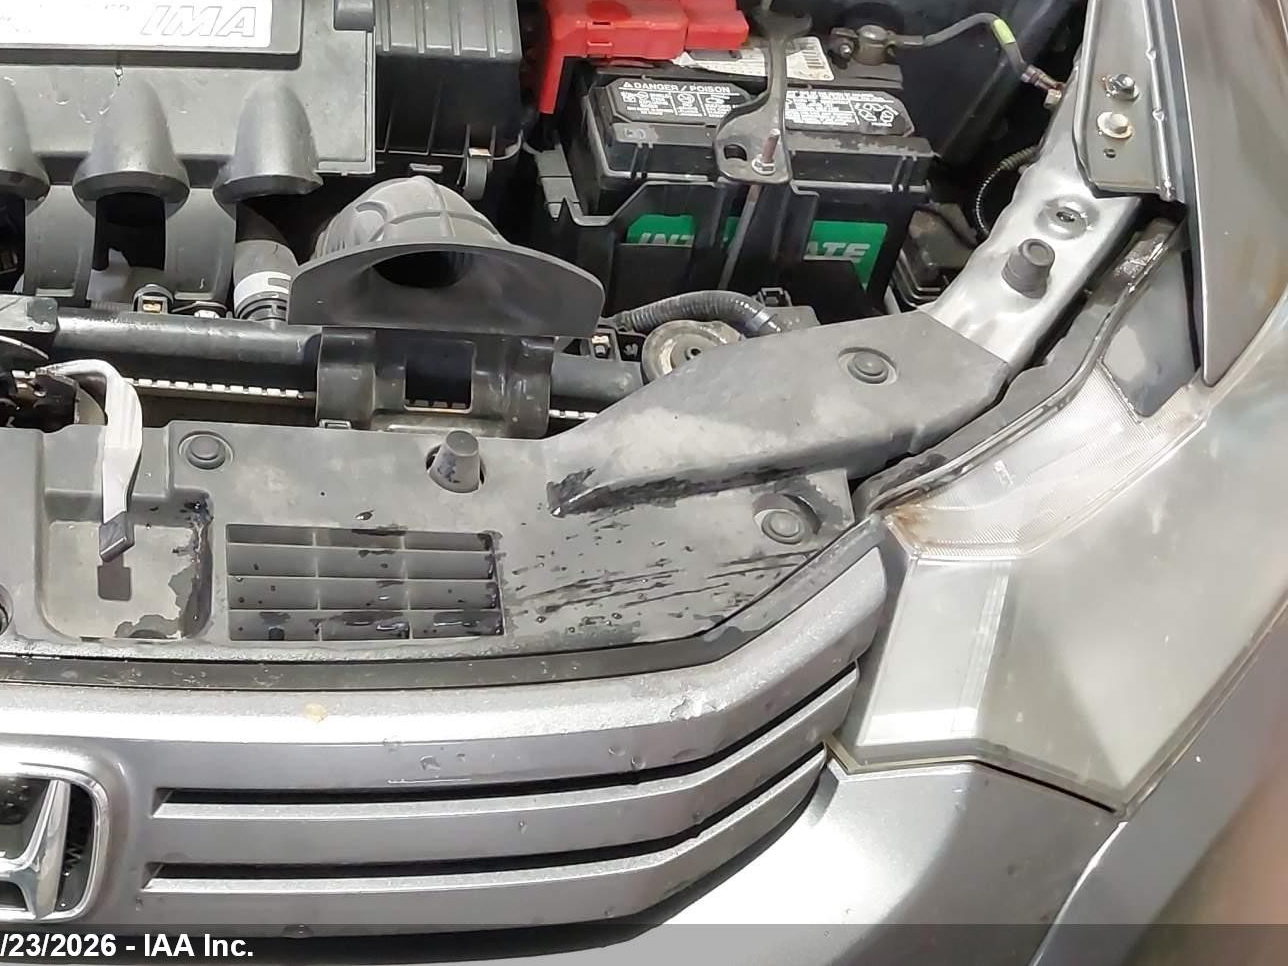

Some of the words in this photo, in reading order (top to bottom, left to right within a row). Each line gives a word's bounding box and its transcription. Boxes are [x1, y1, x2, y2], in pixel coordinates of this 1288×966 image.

[140, 5, 257, 38] IMA
[633, 82, 679, 92] DANGER
[689, 85, 731, 94] POISON
